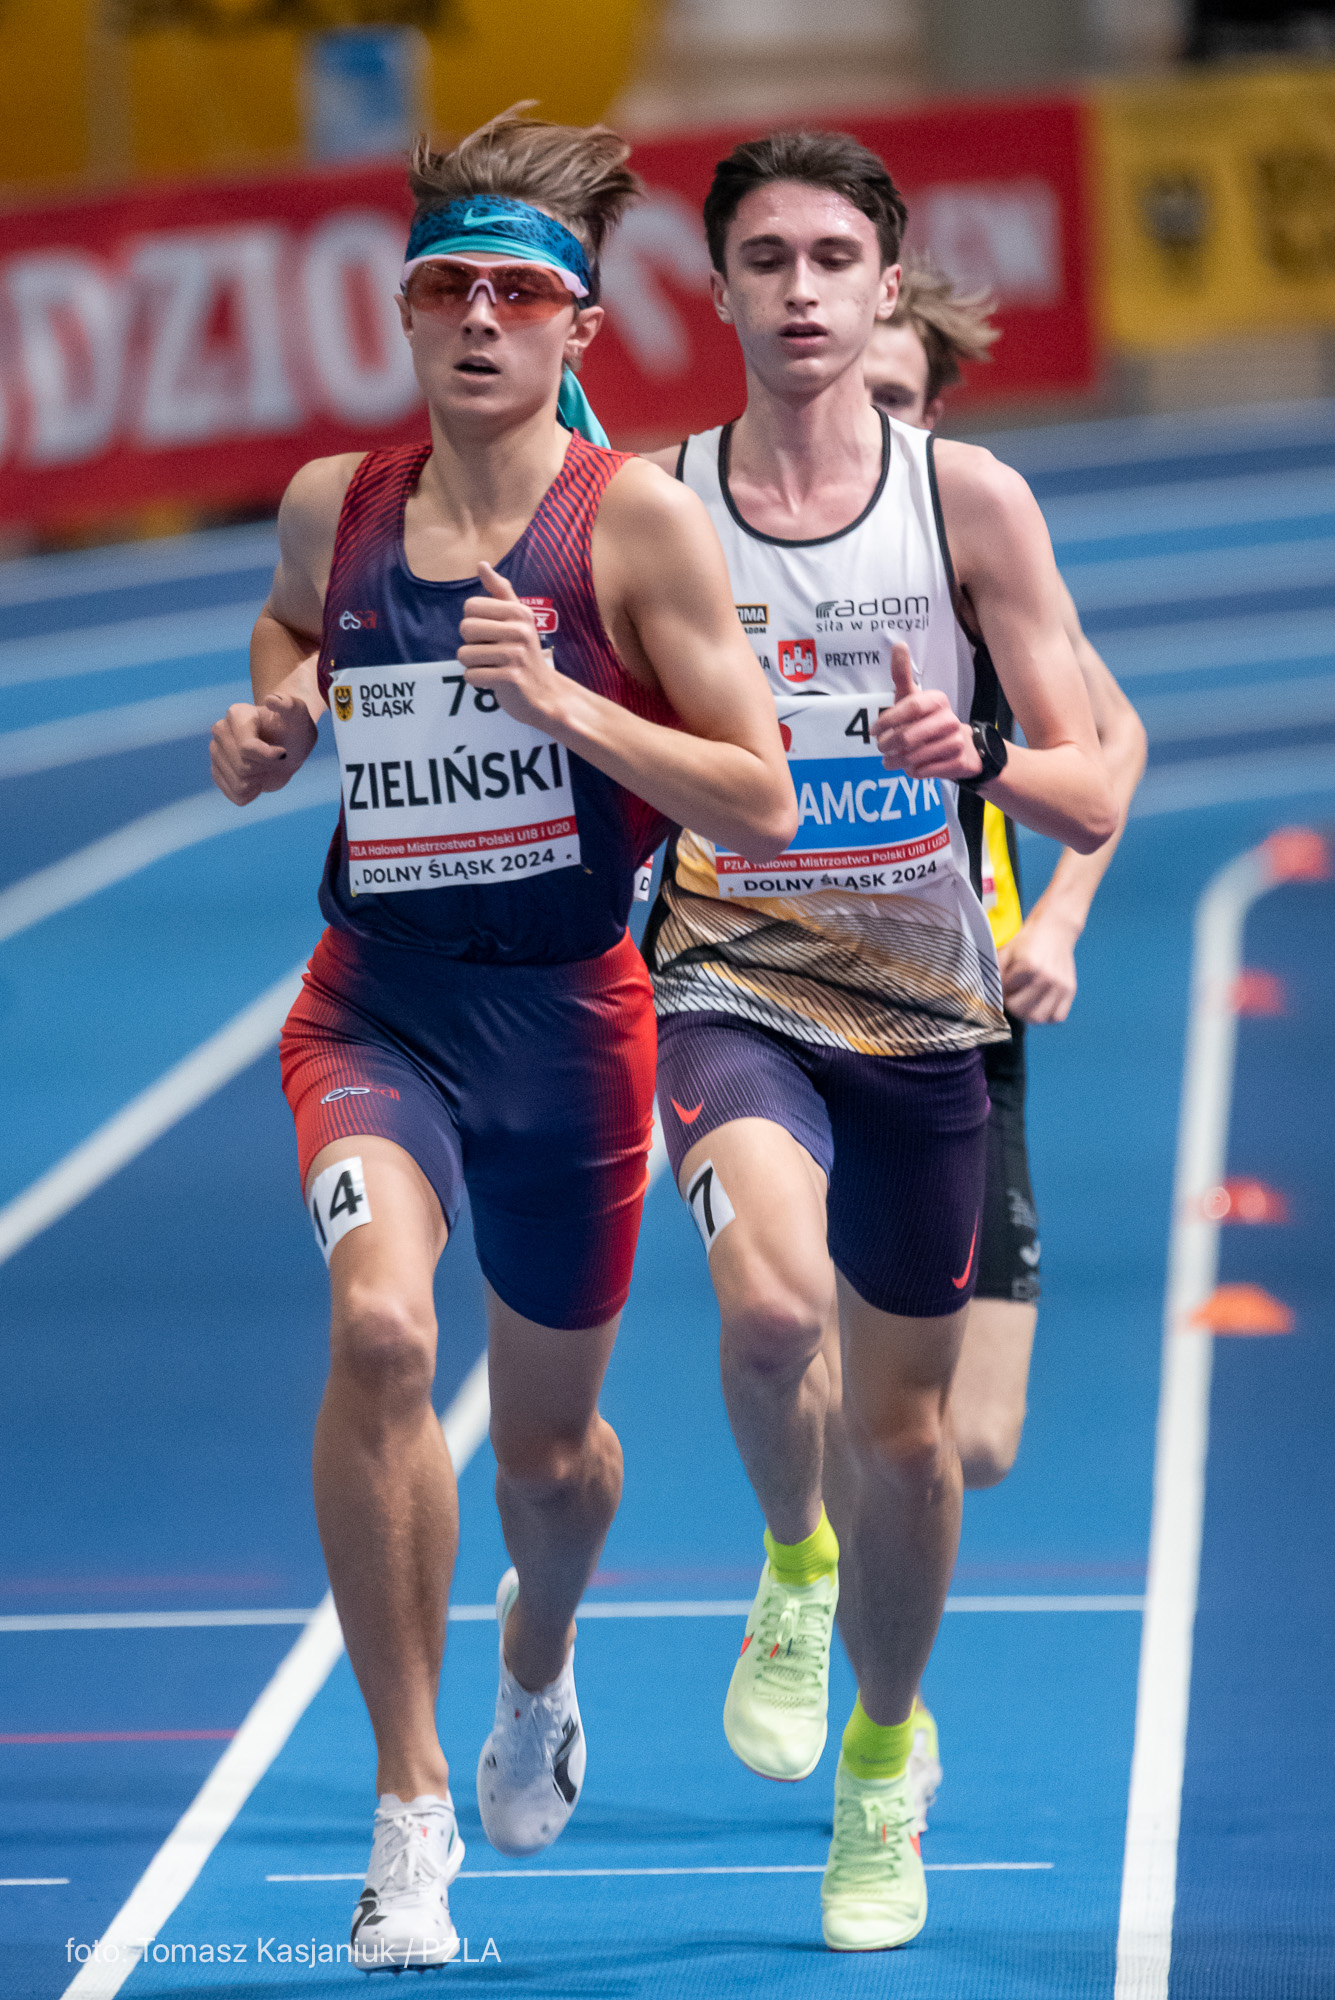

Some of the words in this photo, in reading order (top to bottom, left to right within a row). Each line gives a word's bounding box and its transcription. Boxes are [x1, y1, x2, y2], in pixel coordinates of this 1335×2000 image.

[816, 619, 843, 632] siła
[851, 619, 863, 629] w
[871, 615, 929, 632] precyzji
[825, 651, 880, 667] PRZYTYK
[360, 681, 415, 700] DOLNY
[346, 743, 563, 810] ZIELIŃSKI
[369, 844, 405, 855] Halowe
[407, 839, 476, 854] Mistrzostwa
[478, 832, 515, 846] Polski
[516, 828, 538, 842] U18
[547, 821, 570, 837] U20
[723, 860, 750, 871] PZLA
[799, 855, 870, 868] Mistrzostwa
[873, 851, 905, 863] Polski
[908, 845, 926, 858] U18
[932, 836, 947, 852] U20
[363, 865, 422, 885] DOLNY
[428, 858, 496, 881] ŚLĄSK
[501, 848, 556, 872] 2024
[744, 878, 815, 892] DOLNY
[821, 873, 886, 891] ŚLĄSK
[892, 860, 937, 884] 2024
[313, 1170, 363, 1247] 14
